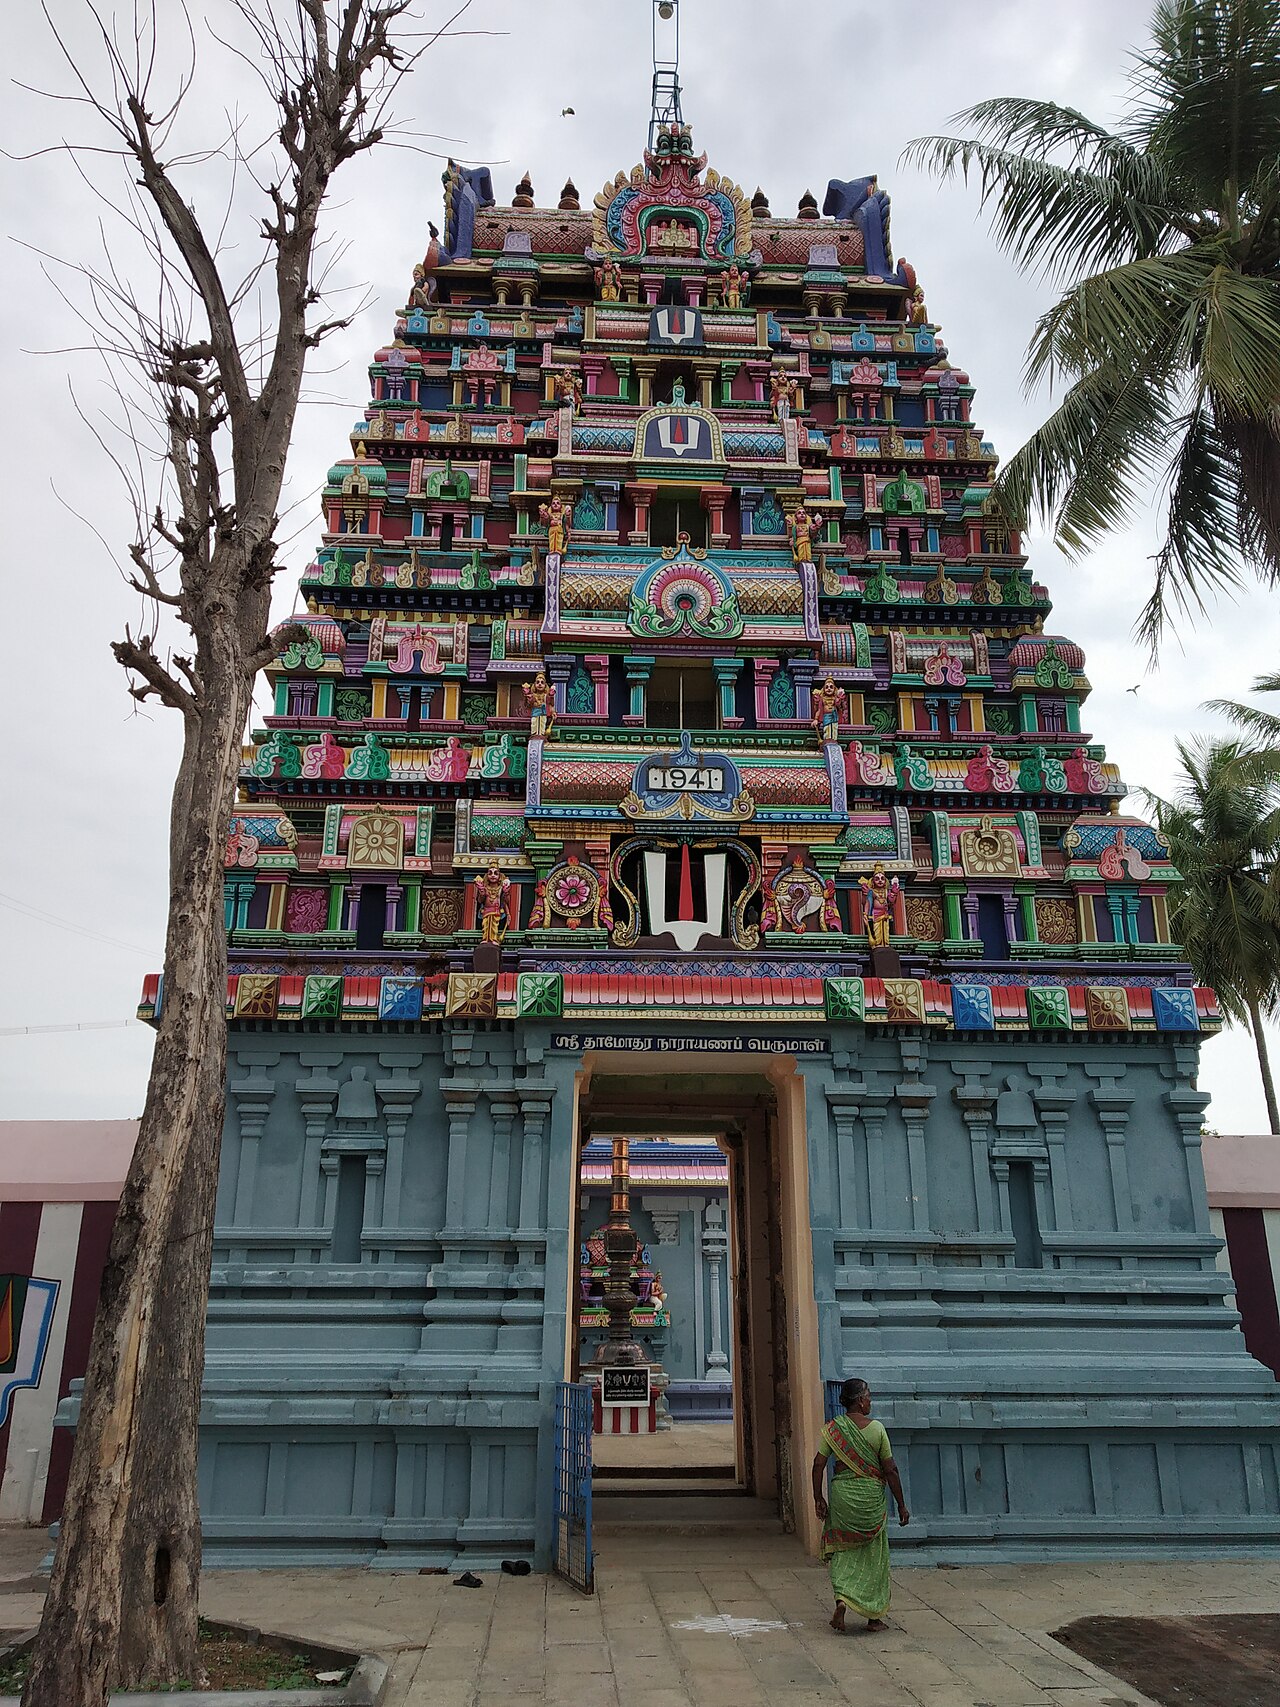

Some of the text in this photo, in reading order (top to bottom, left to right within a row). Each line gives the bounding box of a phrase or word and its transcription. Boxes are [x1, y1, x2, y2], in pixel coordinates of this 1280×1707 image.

[661, 768, 714, 790] 1941
[582, 1035, 653, 1051] தாமோதர
[656, 1036, 743, 1051] நாராயணப்
[747, 1037, 826, 1053] பெருமாள்
